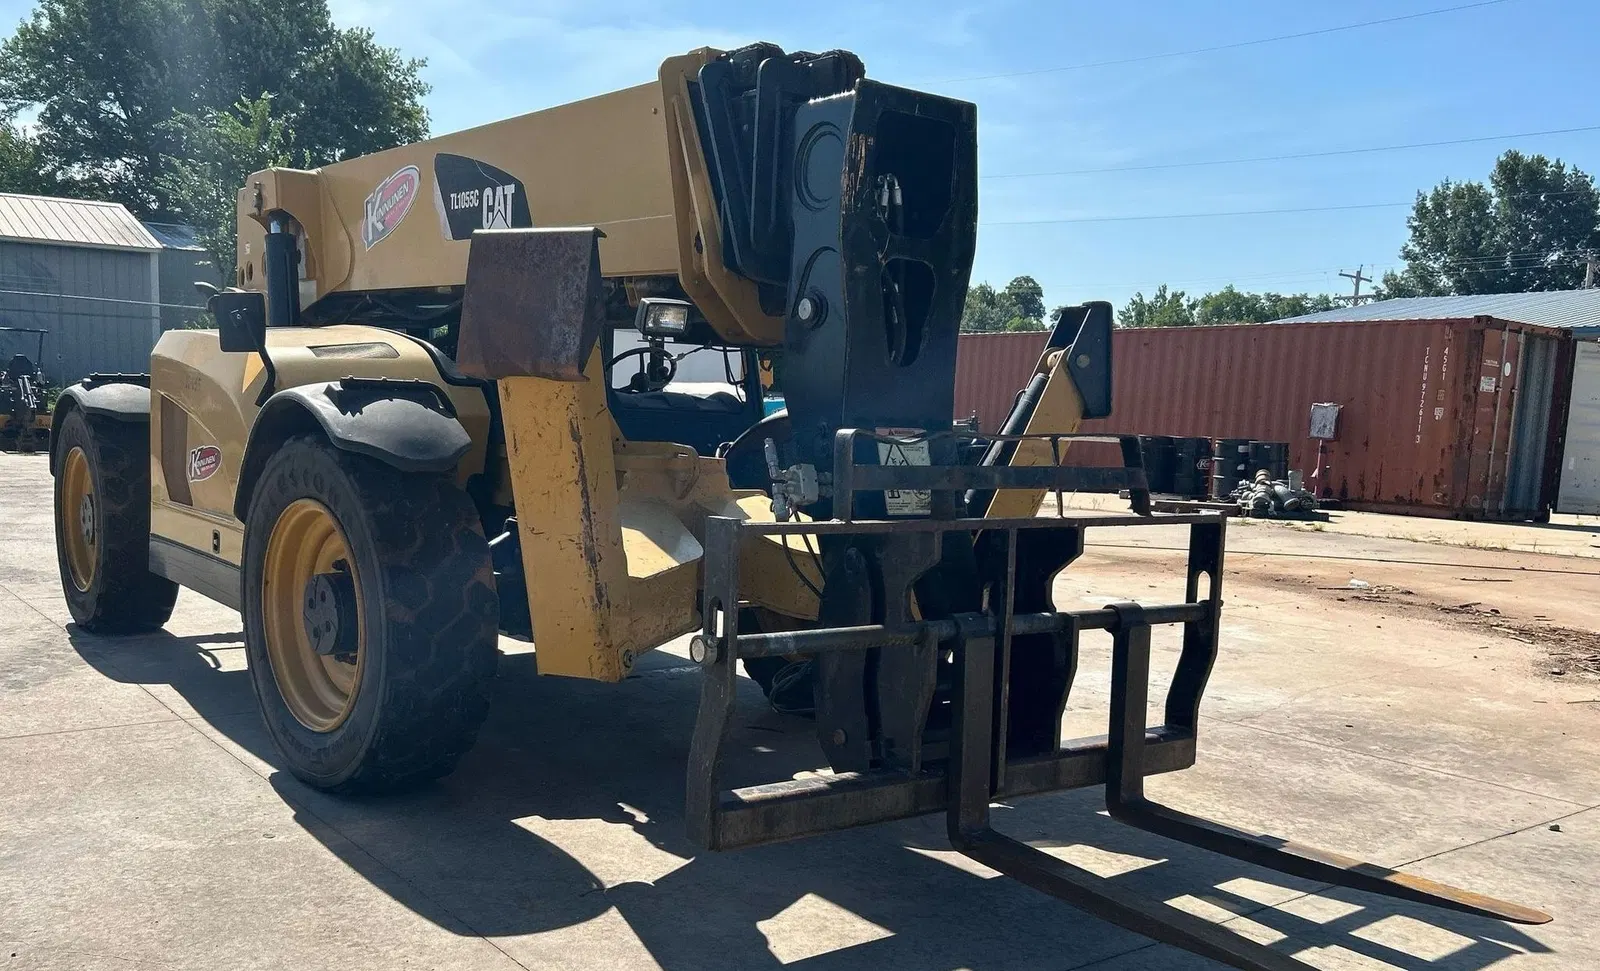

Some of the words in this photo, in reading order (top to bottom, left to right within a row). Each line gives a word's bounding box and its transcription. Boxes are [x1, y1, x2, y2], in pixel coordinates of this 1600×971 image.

[367, 180, 410, 242] KINNUNEN
[450, 189, 480, 210] TL1055C
[482, 183, 515, 229] CAT
